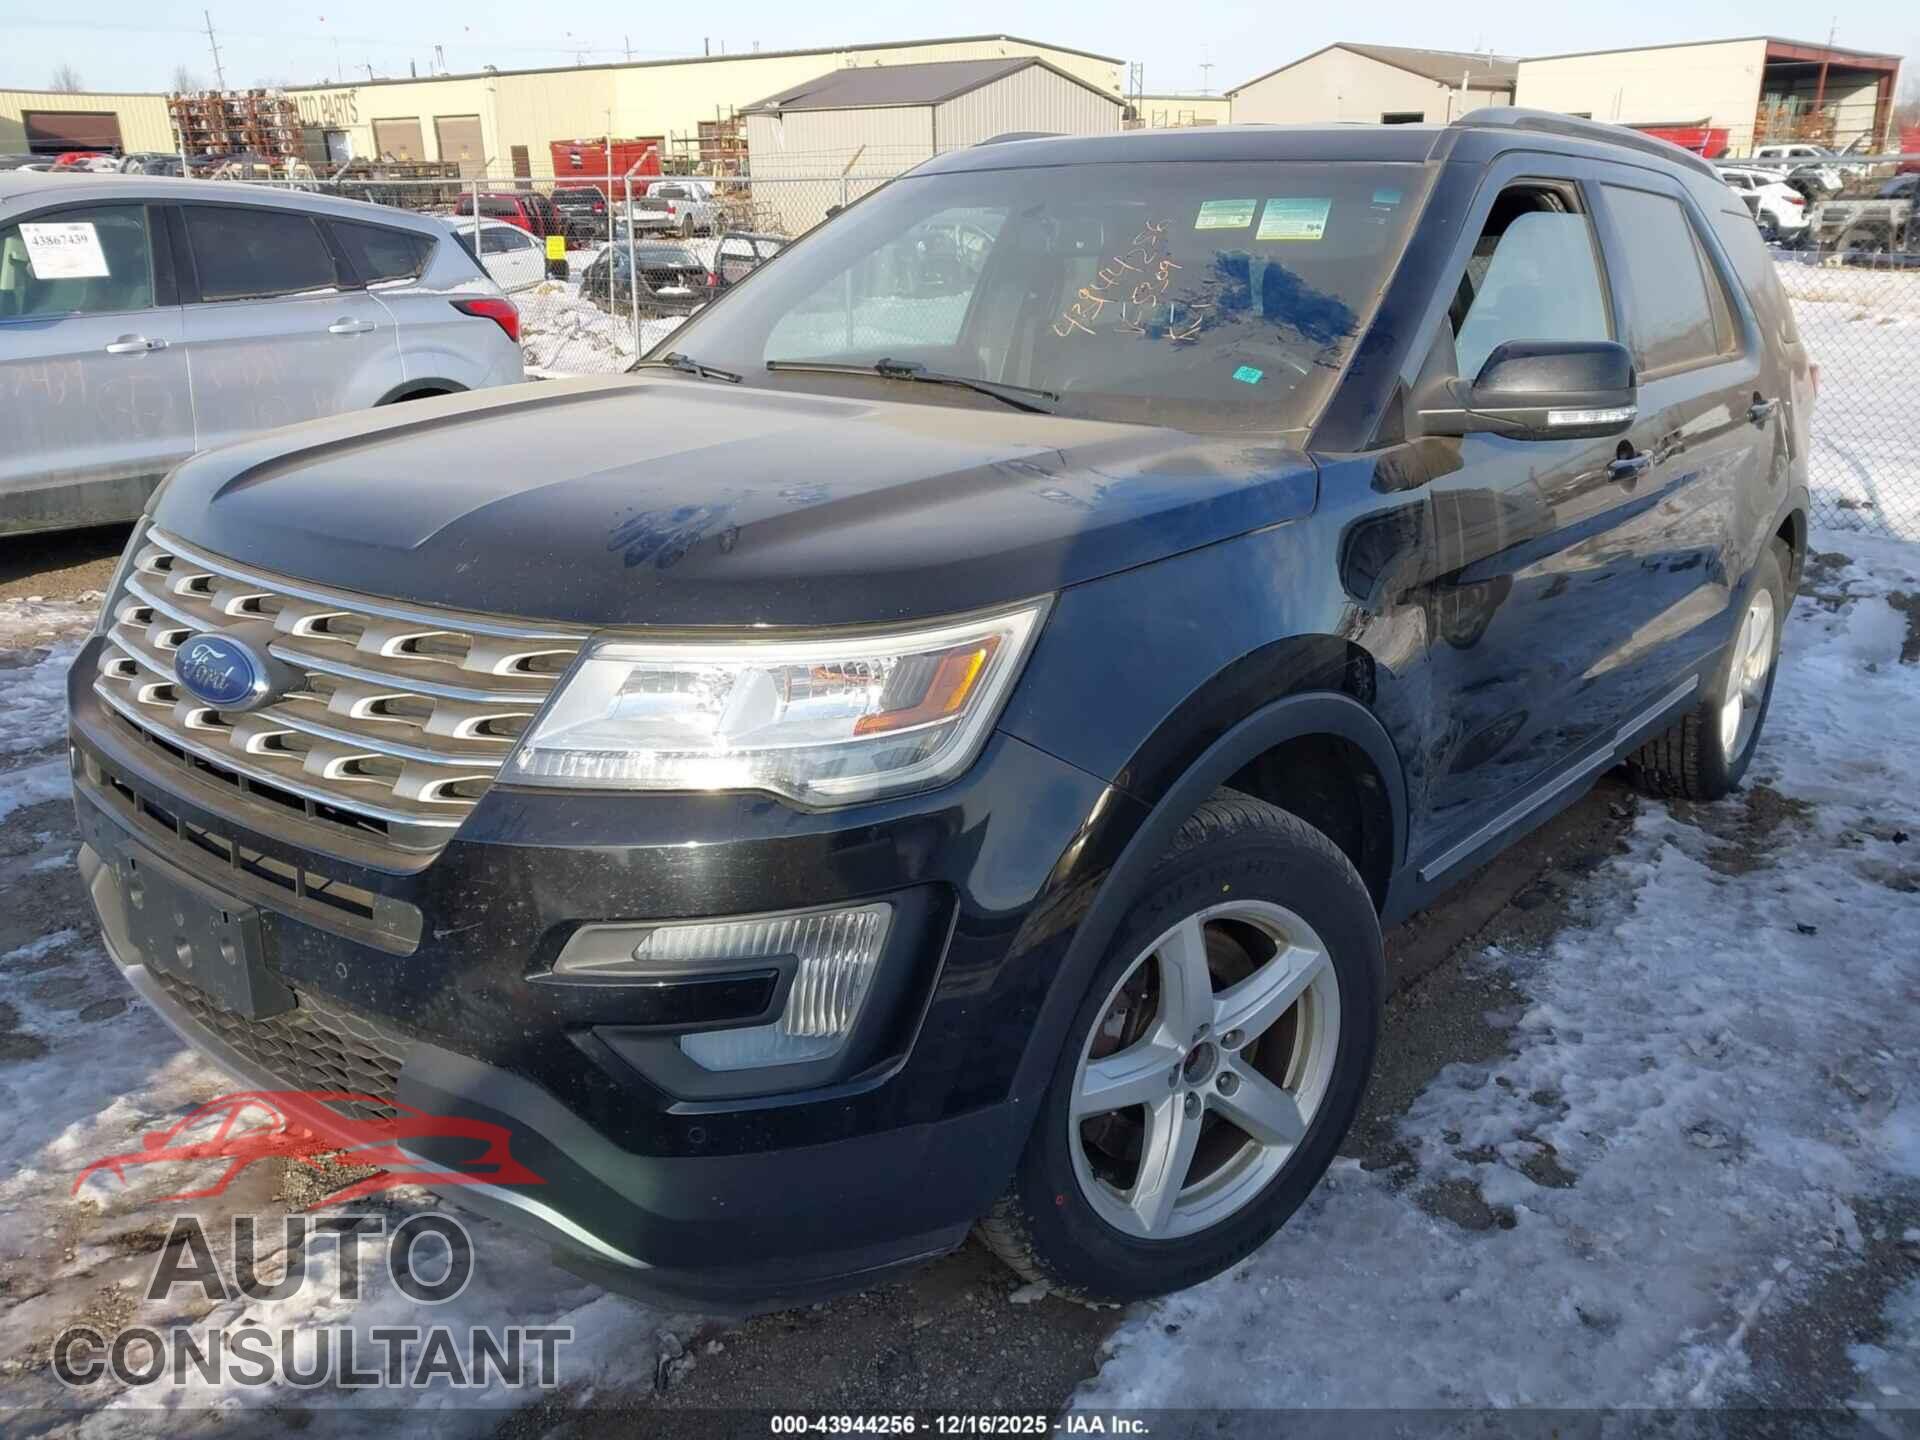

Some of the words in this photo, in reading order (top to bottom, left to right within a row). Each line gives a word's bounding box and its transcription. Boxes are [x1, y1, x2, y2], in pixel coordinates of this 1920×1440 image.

[320, 88, 358, 124] PARTS
[32, 233, 89, 246] 43867439
[183, 643, 235, 689] Ford
